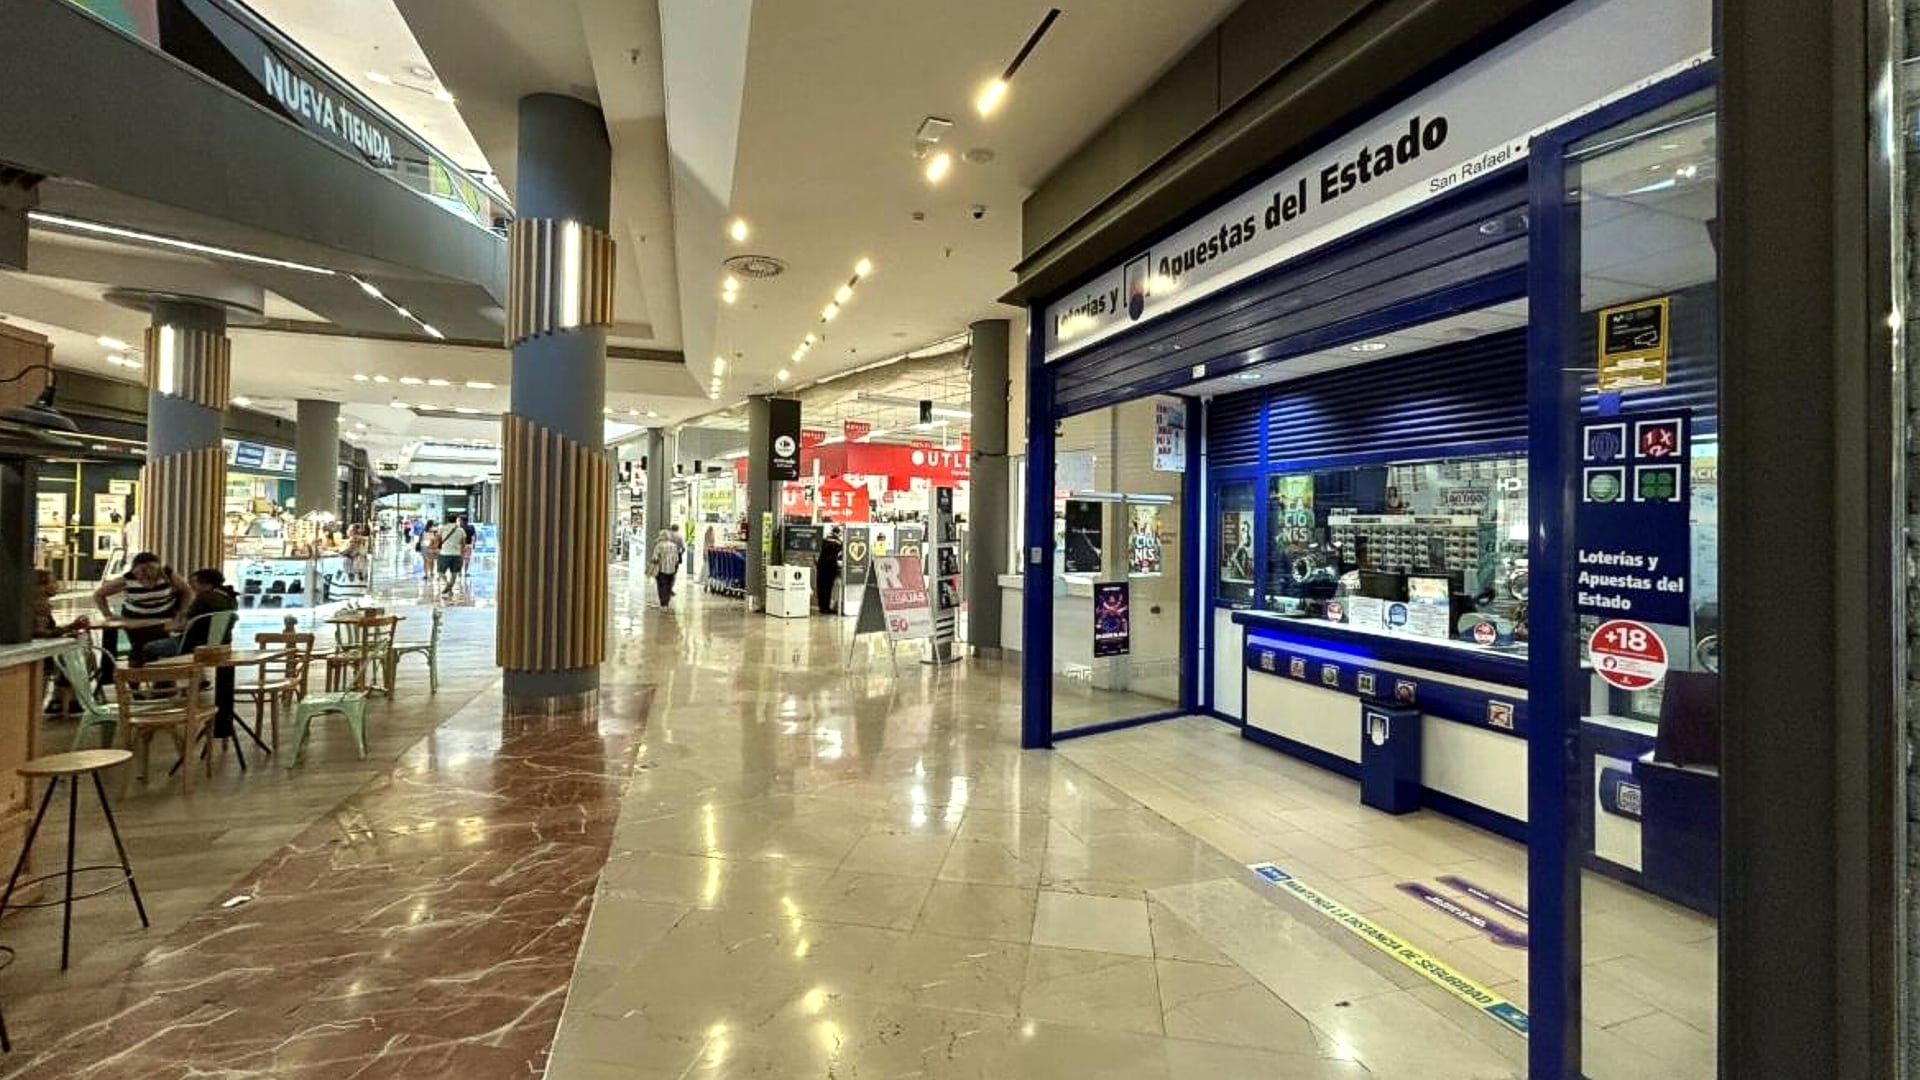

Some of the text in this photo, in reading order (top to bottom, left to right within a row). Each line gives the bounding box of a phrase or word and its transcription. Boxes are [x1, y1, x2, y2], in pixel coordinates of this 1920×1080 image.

[263, 55, 393, 166] NUEVA TIENDA
[1429, 143, 1511, 193] San Rafael
[1109, 287, 1118, 315] y
[1157, 214, 1256, 282] Apuestas
[1264, 177, 1307, 231] del
[1320, 111, 1448, 203] Estado
[1579, 549, 1659, 571] Loterías y
[1578, 571, 1684, 593] Apuestas del
[1578, 591, 1632, 610] Estado
[1605, 627, 1648, 652] +18
[1331, 907, 1349, 919] LA
[1399, 948, 1419, 961] DE
[1416, 957, 1494, 1005] SEGURIDAD
